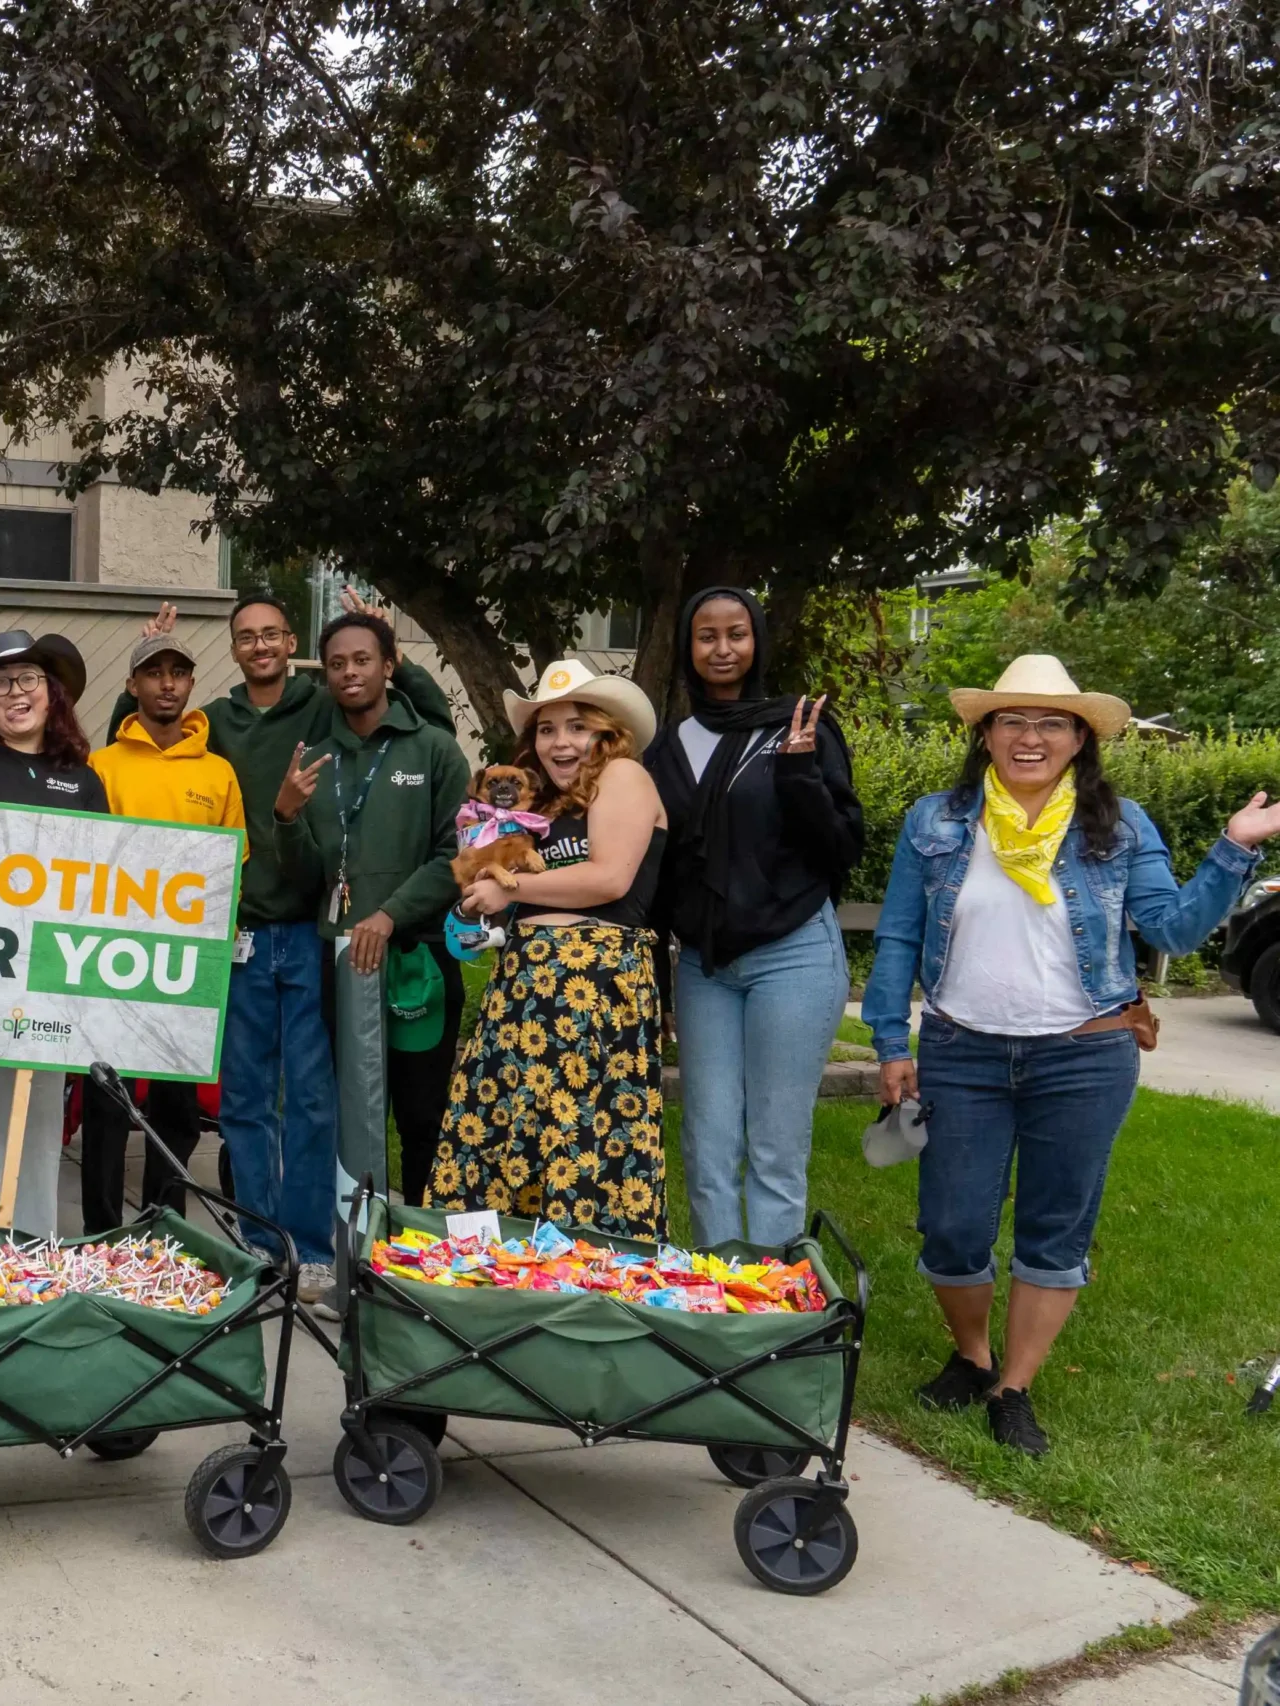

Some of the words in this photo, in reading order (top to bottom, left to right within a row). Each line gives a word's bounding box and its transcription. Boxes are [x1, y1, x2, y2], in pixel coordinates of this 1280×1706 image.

[53, 932, 199, 995] YOU
[32, 1019, 72, 1035] trellis
[31, 1033, 71, 1044] SOCIETY
